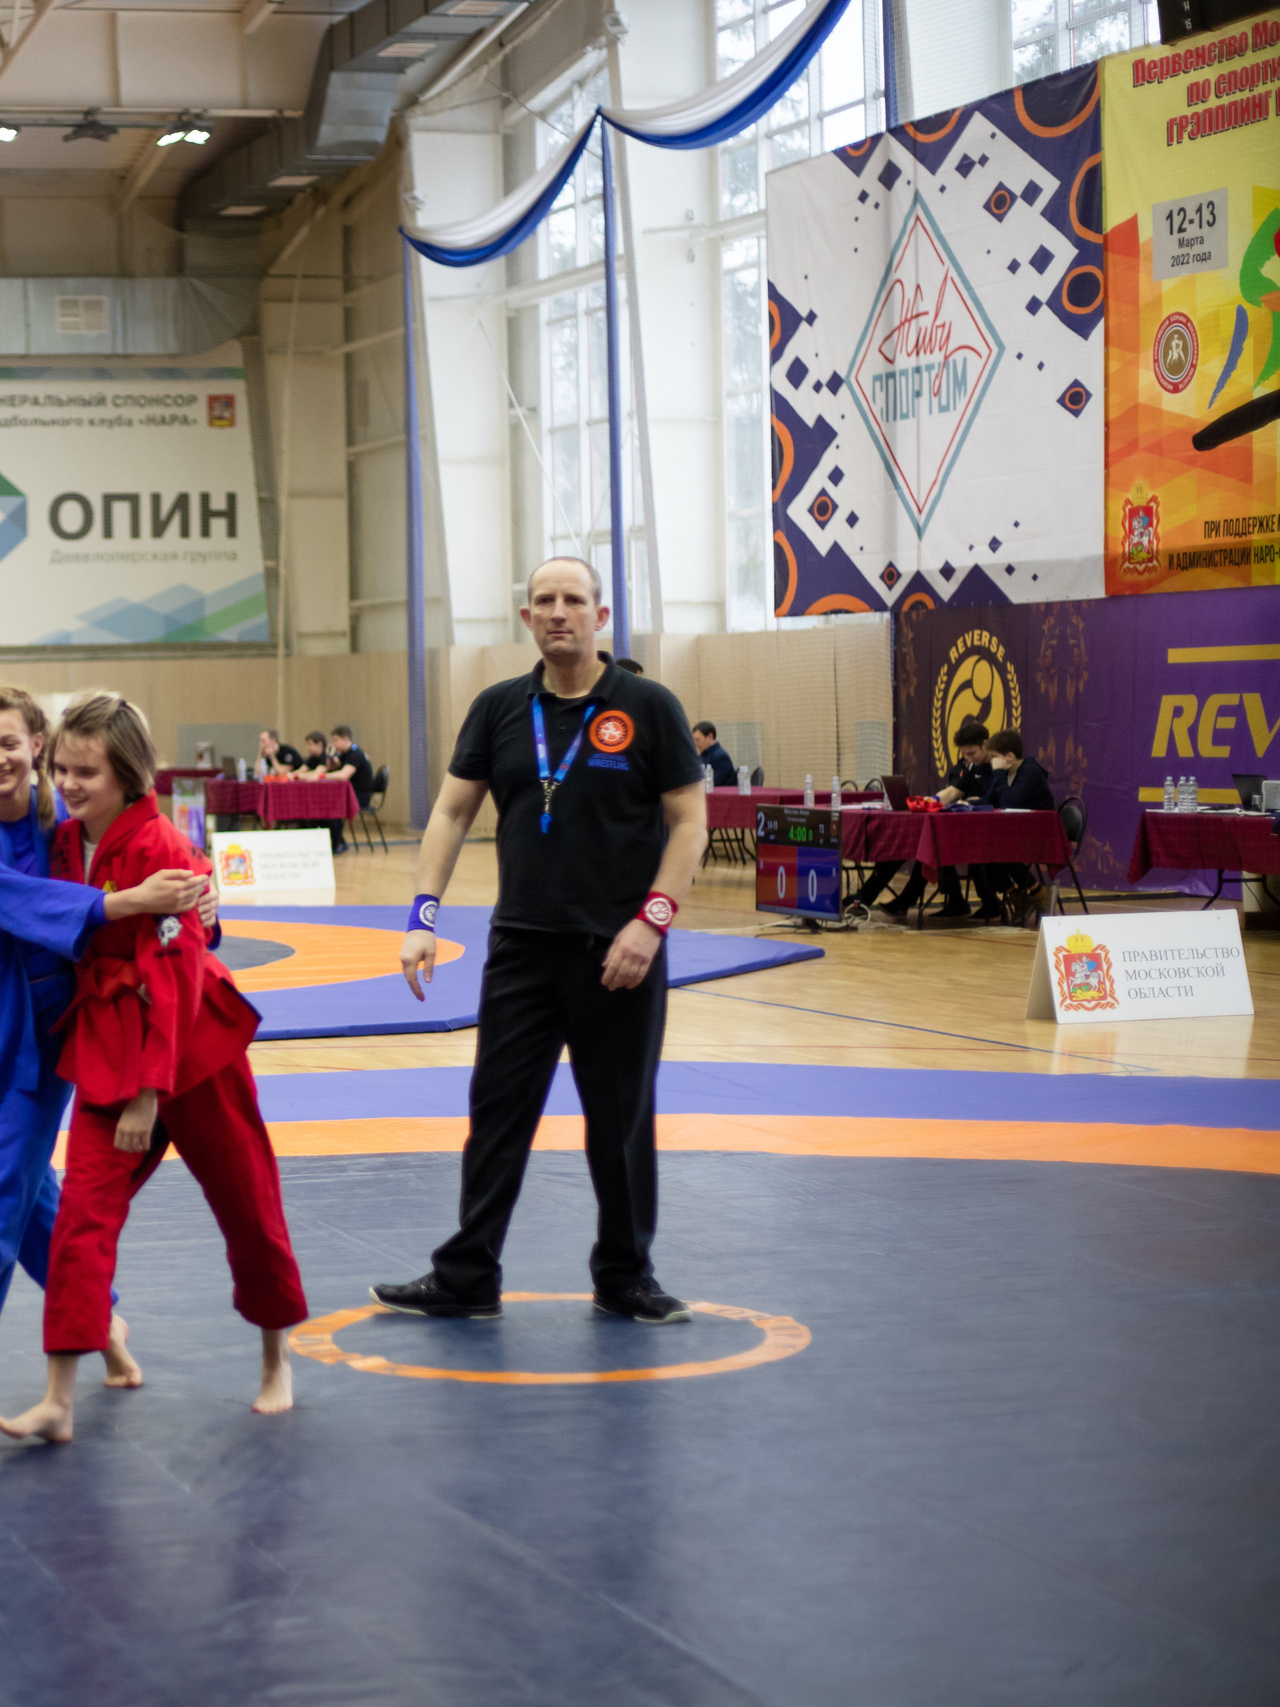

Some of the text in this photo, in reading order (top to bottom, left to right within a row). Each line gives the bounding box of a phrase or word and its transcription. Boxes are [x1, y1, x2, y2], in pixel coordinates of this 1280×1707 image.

[1133, 31, 1249, 88] Первенство
[1187, 78, 1211, 107] по
[1167, 89, 1272, 147] ГРЭППЛИНГ
[1165, 200, 1216, 235] 12-13
[1178, 235, 1205, 250] Марта
[1171, 251, 1212, 268] 2022 года
[111, 393, 199, 408] СПОНСОР
[872, 356, 967, 423] СПОРТОМ
[47, 491, 238, 541] ОПИН
[1204, 520, 1221, 539] ПРИ
[1223, 514, 1276, 539] ПОДДЕРЖКЕ
[1176, 546, 1252, 572] АДМИНИСТРАЦИИ
[1254, 544, 1280, 565] НАРО-
[949, 629, 1006, 665] REVERSE
[1151, 692, 1280, 758] REV
[757, 811, 765, 837] 2
[789, 825, 807, 842] 4:00
[777, 865, 817, 904] 0 0
[1122, 946, 1240, 962] ПРАВИТЕЛЬСТВО
[1125, 963, 1226, 981] МОСКОВСКОЙ
[1127, 985, 1195, 999] ОБЛАСТИ
